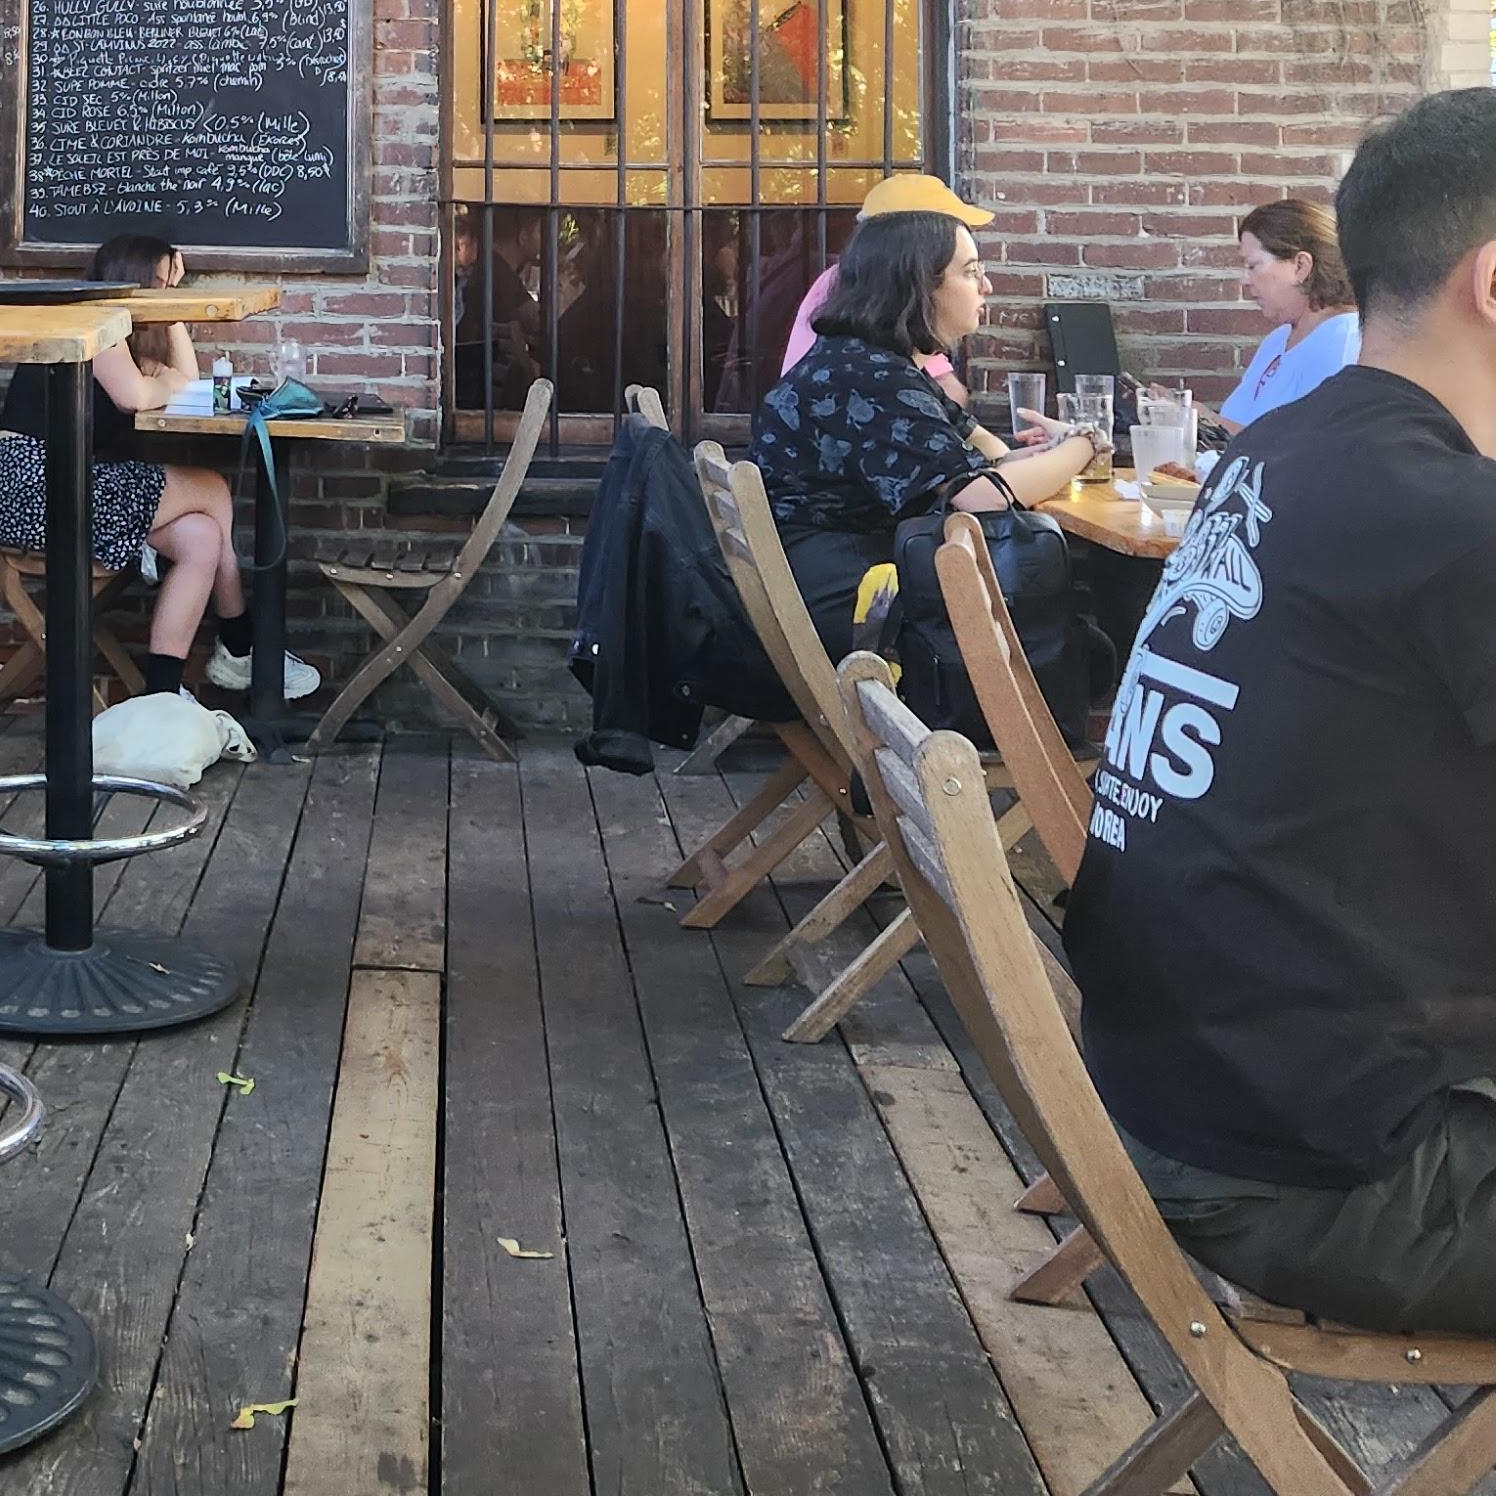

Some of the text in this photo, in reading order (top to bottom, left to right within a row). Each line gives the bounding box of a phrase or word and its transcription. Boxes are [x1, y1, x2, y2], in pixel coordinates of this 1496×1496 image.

[54, 0, 91, 15] HULLY
[95, 0, 136, 15] GULLY
[139, 27, 184, 37] BERLINER
[147, 39, 177, 48] 2022
[94, 65, 142, 77] CONTACT
[88, 78, 130, 89] POMME
[82, 94, 102, 105] SEC
[51, 122, 81, 135] SURE
[85, 121, 128, 132] BLEUET
[145, 117, 196, 132] HIBISCUS
[258, 111, 310, 136] (Mille)
[50, 138, 88, 151] LIME
[100, 134, 173, 149] CORIANDRE
[49, 155, 64, 166] LE
[67, 154, 102, 165] SOLEIL
[107, 152, 127, 163] EST
[131, 148, 160, 162] PRÈS
[164, 149, 181, 160] DE
[90, 166, 132, 181] MORTEL
[258, 162, 293, 182] (DDC)
[54, 203, 87, 216] STOUT
[104, 200, 163, 215] L'AVOINE
[225, 196, 282, 221] (Mille)
